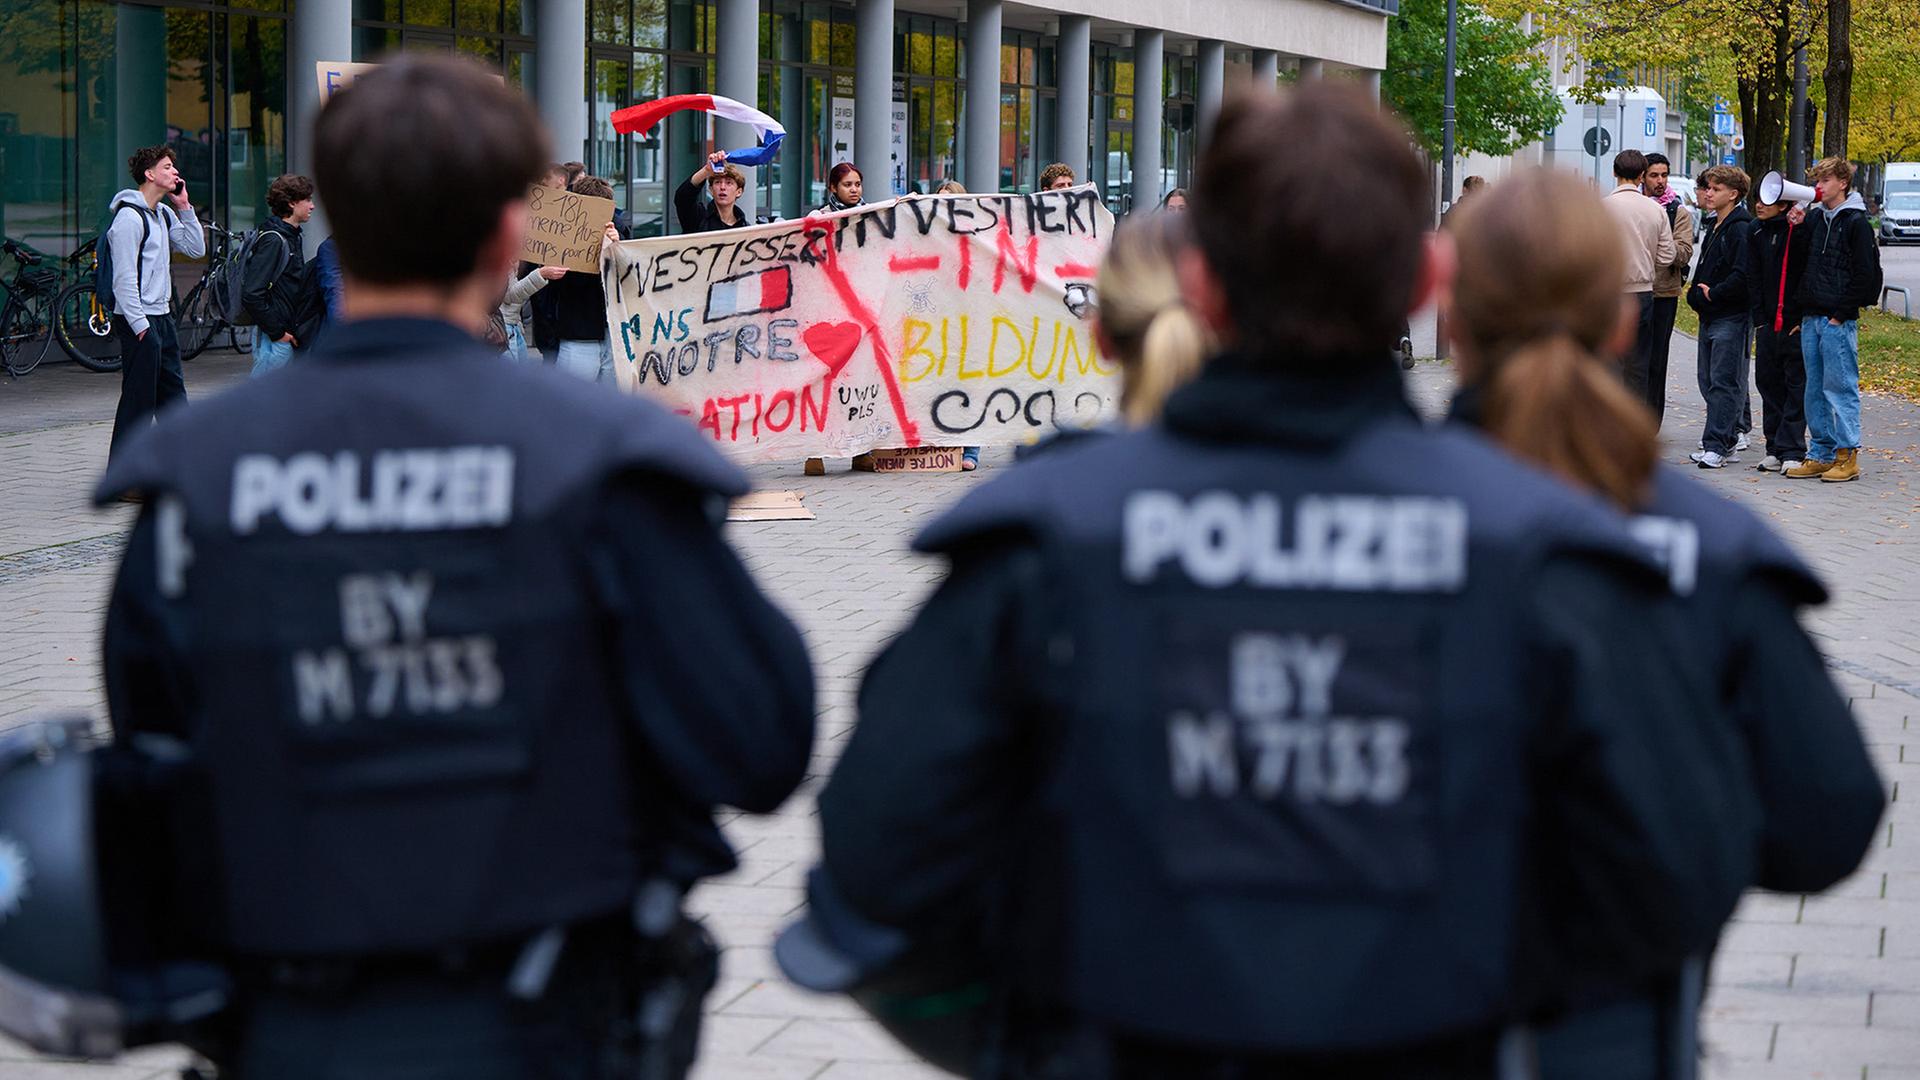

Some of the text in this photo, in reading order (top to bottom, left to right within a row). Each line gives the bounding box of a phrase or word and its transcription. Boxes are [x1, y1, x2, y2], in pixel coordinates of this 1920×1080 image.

[1646, 122, 1655, 136] U
[523, 238, 558, 264] emps
[836, 189, 1098, 252] INVESTIERT
[639, 318, 800, 385] NOTRE
[697, 376, 834, 442] ATION
[847, 402, 875, 421] PLS
[229, 446, 516, 535] POLIZEI
[910, 453, 954, 470] NOTRE
[1122, 489, 1469, 592] POLIZEI
[338, 569, 434, 650] BY
[360, 634, 505, 718] 7133
[1231, 631, 1347, 719] BY
[1246, 715, 1409, 804] 7133
